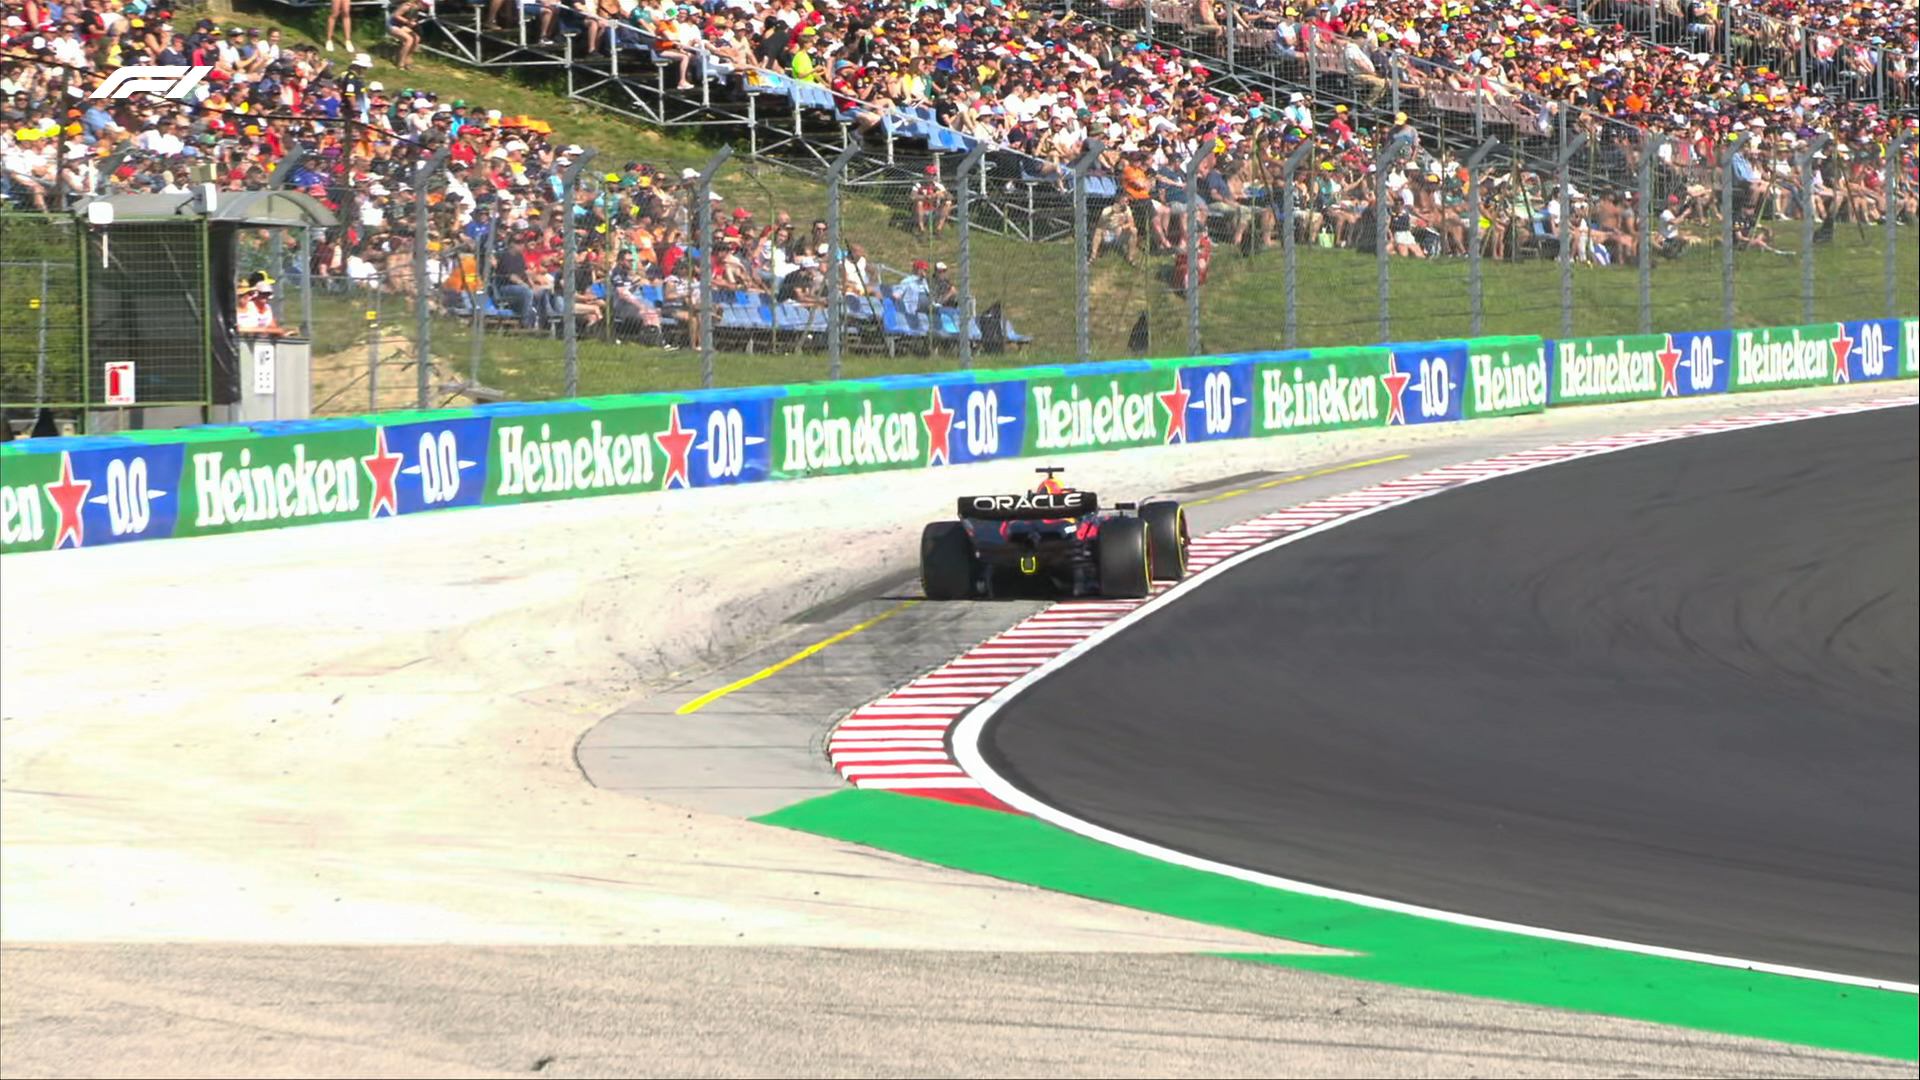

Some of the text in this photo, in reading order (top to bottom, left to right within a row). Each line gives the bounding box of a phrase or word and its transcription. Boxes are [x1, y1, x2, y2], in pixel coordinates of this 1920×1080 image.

[1559, 339, 1657, 398] Heineken
[1736, 328, 1829, 385] Heineken
[1033, 381, 1157, 449] Heineken
[1262, 364, 1379, 430] Heineken
[497, 408, 743, 496] Heineken 0.0
[783, 399, 920, 471] Heineken
[193, 430, 460, 527] Heineken 0.0
[973, 492, 1082, 511] ORACLE
